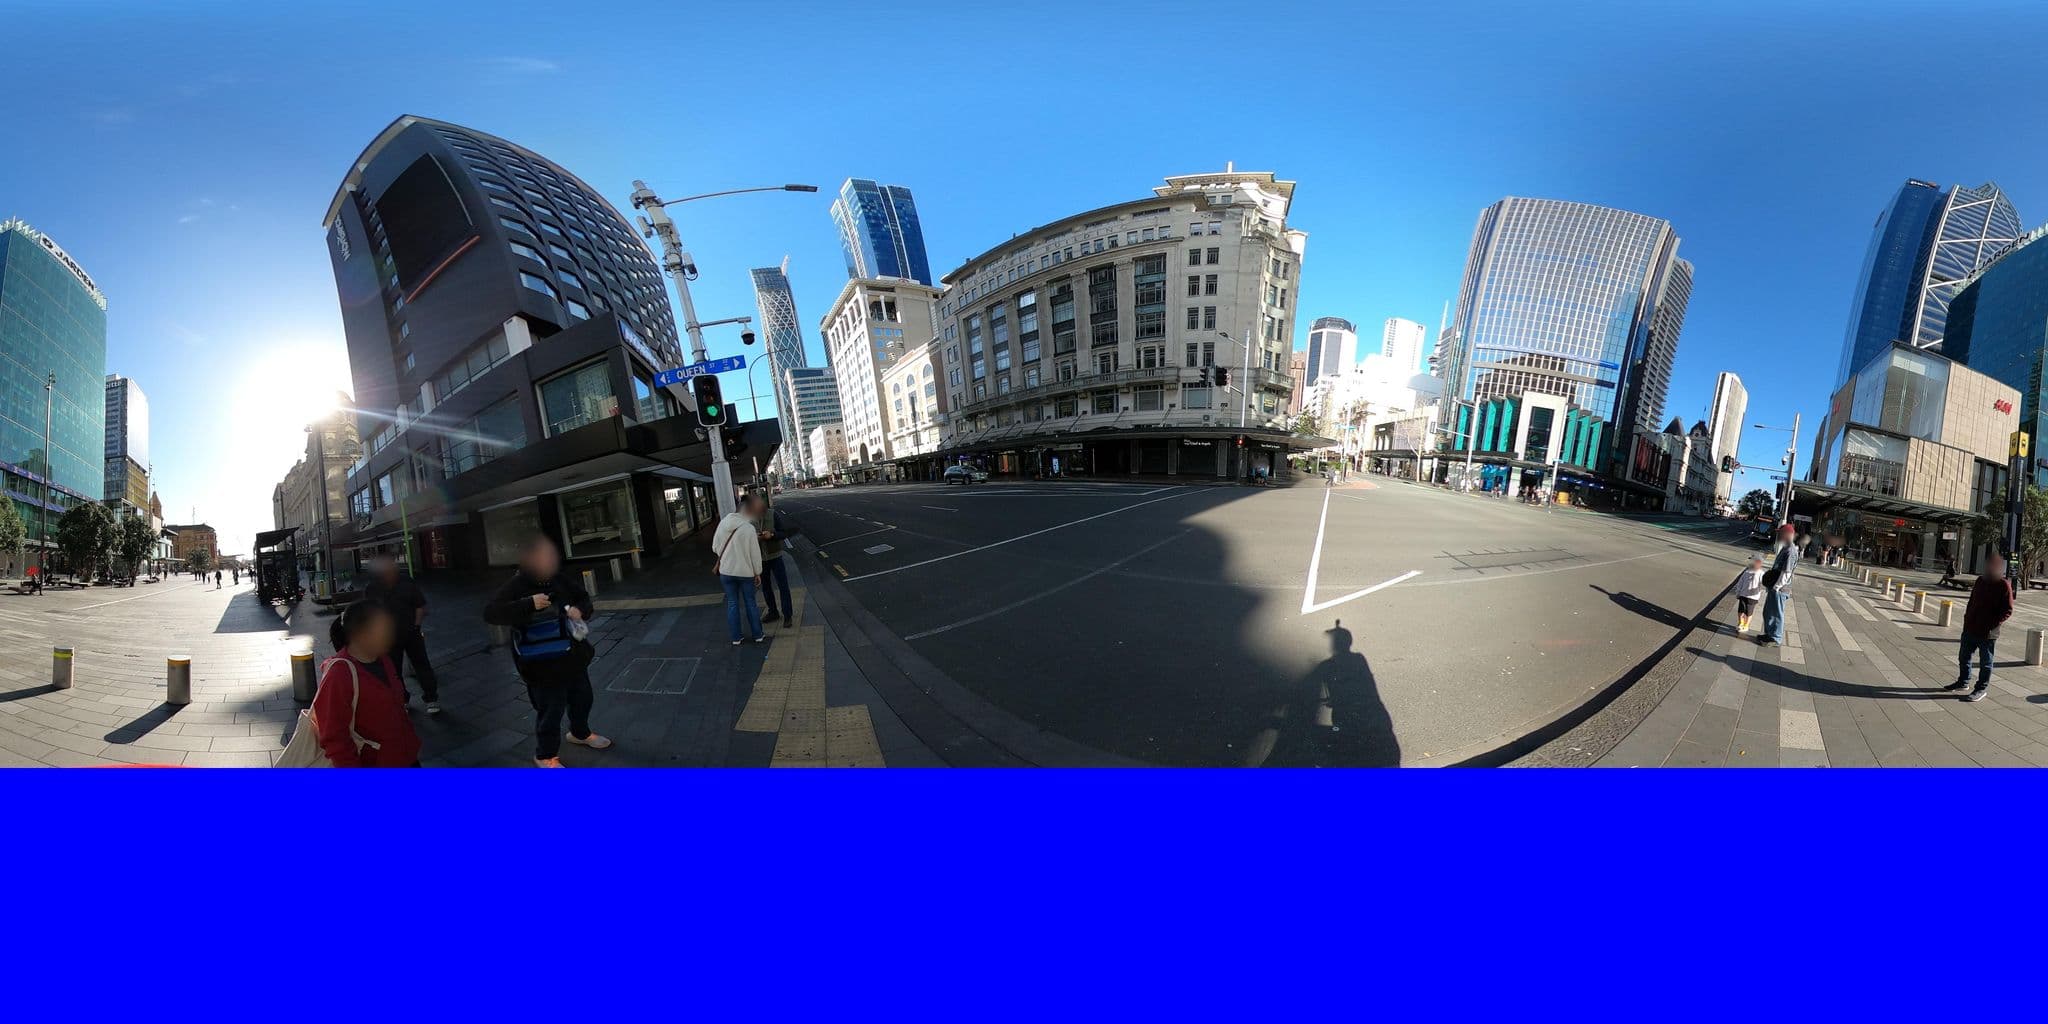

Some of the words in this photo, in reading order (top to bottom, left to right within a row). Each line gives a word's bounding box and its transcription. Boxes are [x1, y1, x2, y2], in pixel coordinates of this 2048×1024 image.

[55, 250, 95, 291] JARDEN
[1978, 232, 2030, 271] JARDEN
[676, 365, 706, 380] QUEEN
